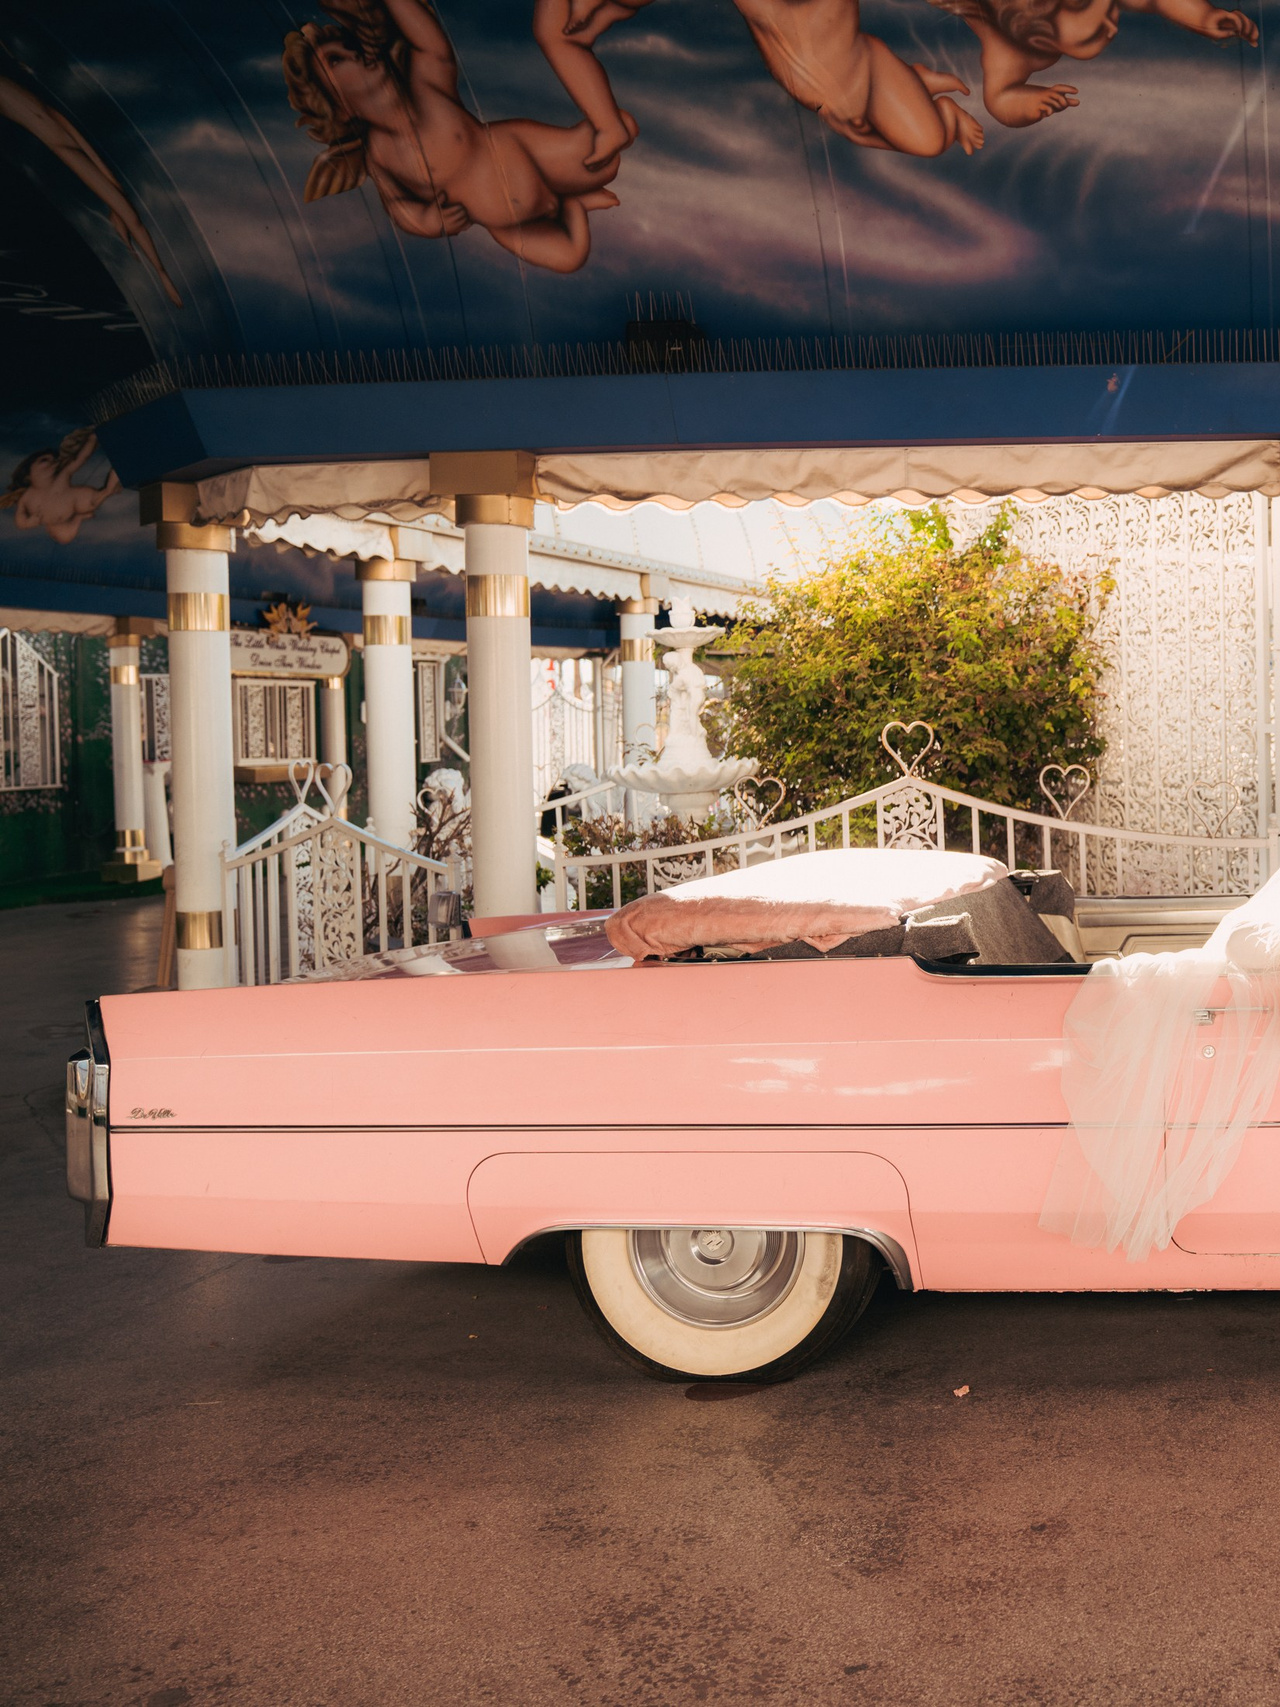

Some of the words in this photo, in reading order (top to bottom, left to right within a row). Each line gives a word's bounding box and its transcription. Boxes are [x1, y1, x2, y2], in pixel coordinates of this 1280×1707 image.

[245, 634, 264, 648] Little
[289, 638, 317, 656] Wedding
[320, 640, 341, 657] Chapel
